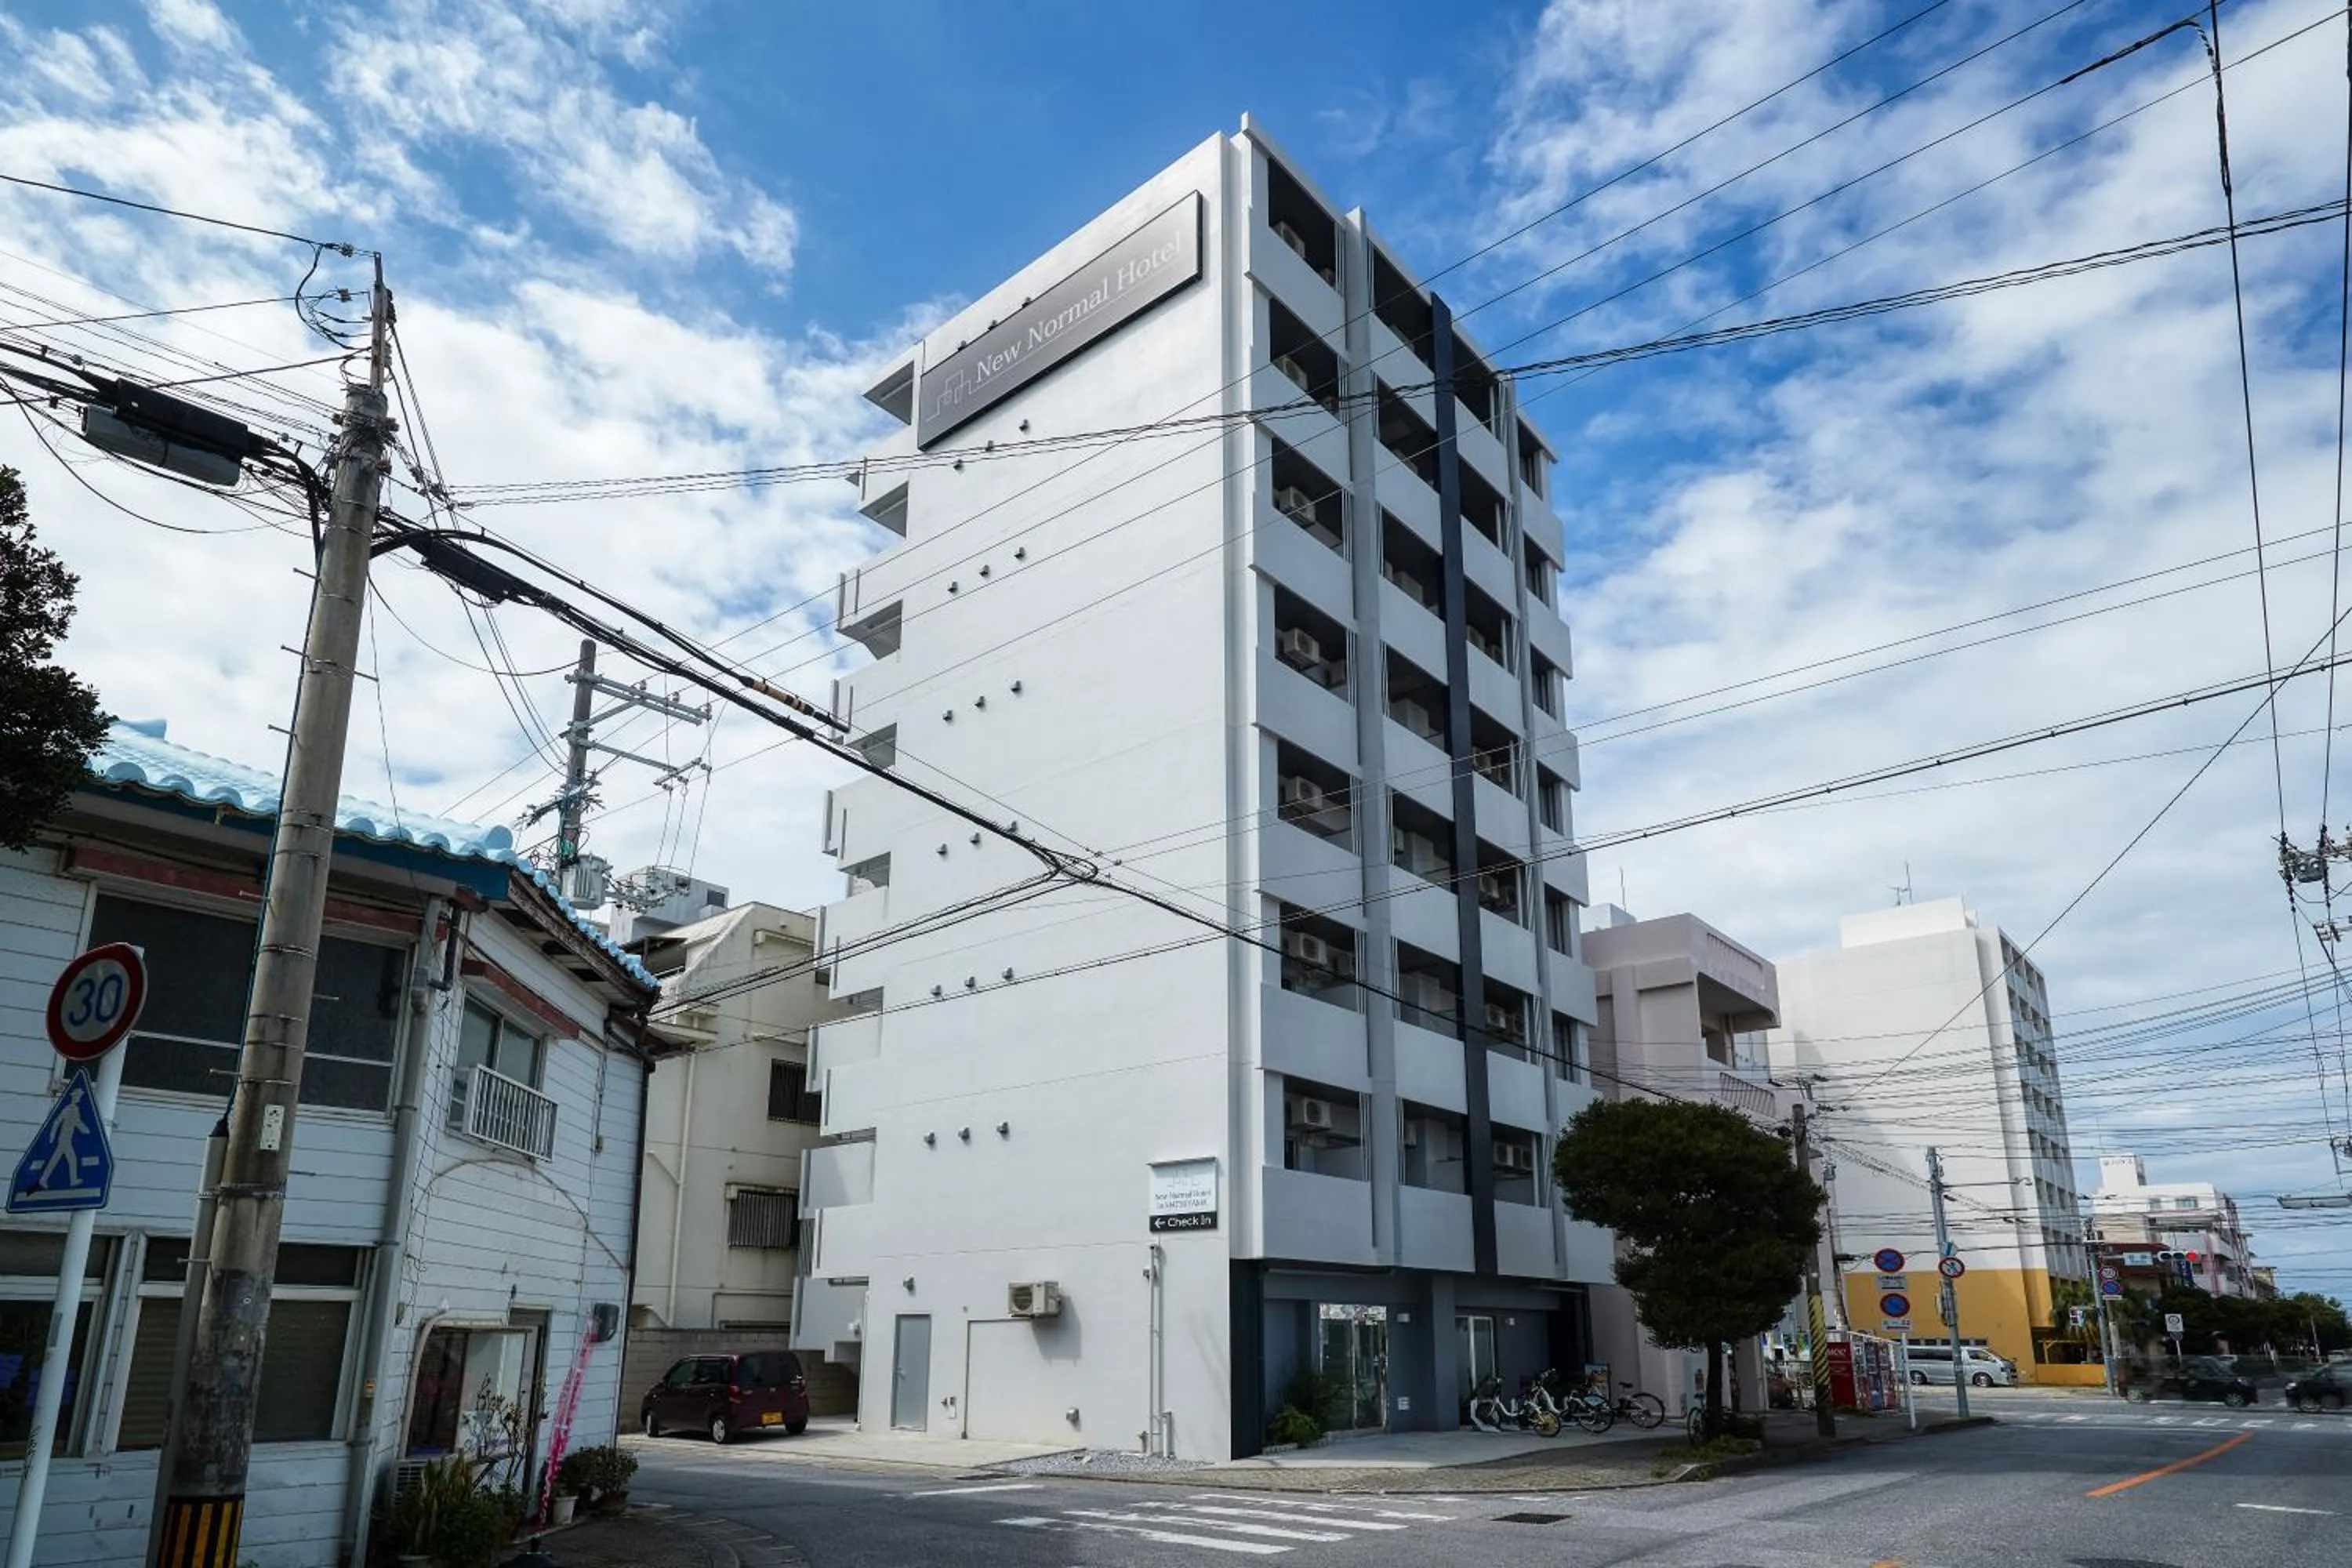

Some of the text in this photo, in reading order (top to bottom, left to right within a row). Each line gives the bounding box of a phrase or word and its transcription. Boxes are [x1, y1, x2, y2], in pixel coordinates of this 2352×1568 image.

[976, 231, 1181, 383] New Normal Hotel
[68, 974, 123, 1027] 30
[1167, 1214, 1211, 1227] Check In
